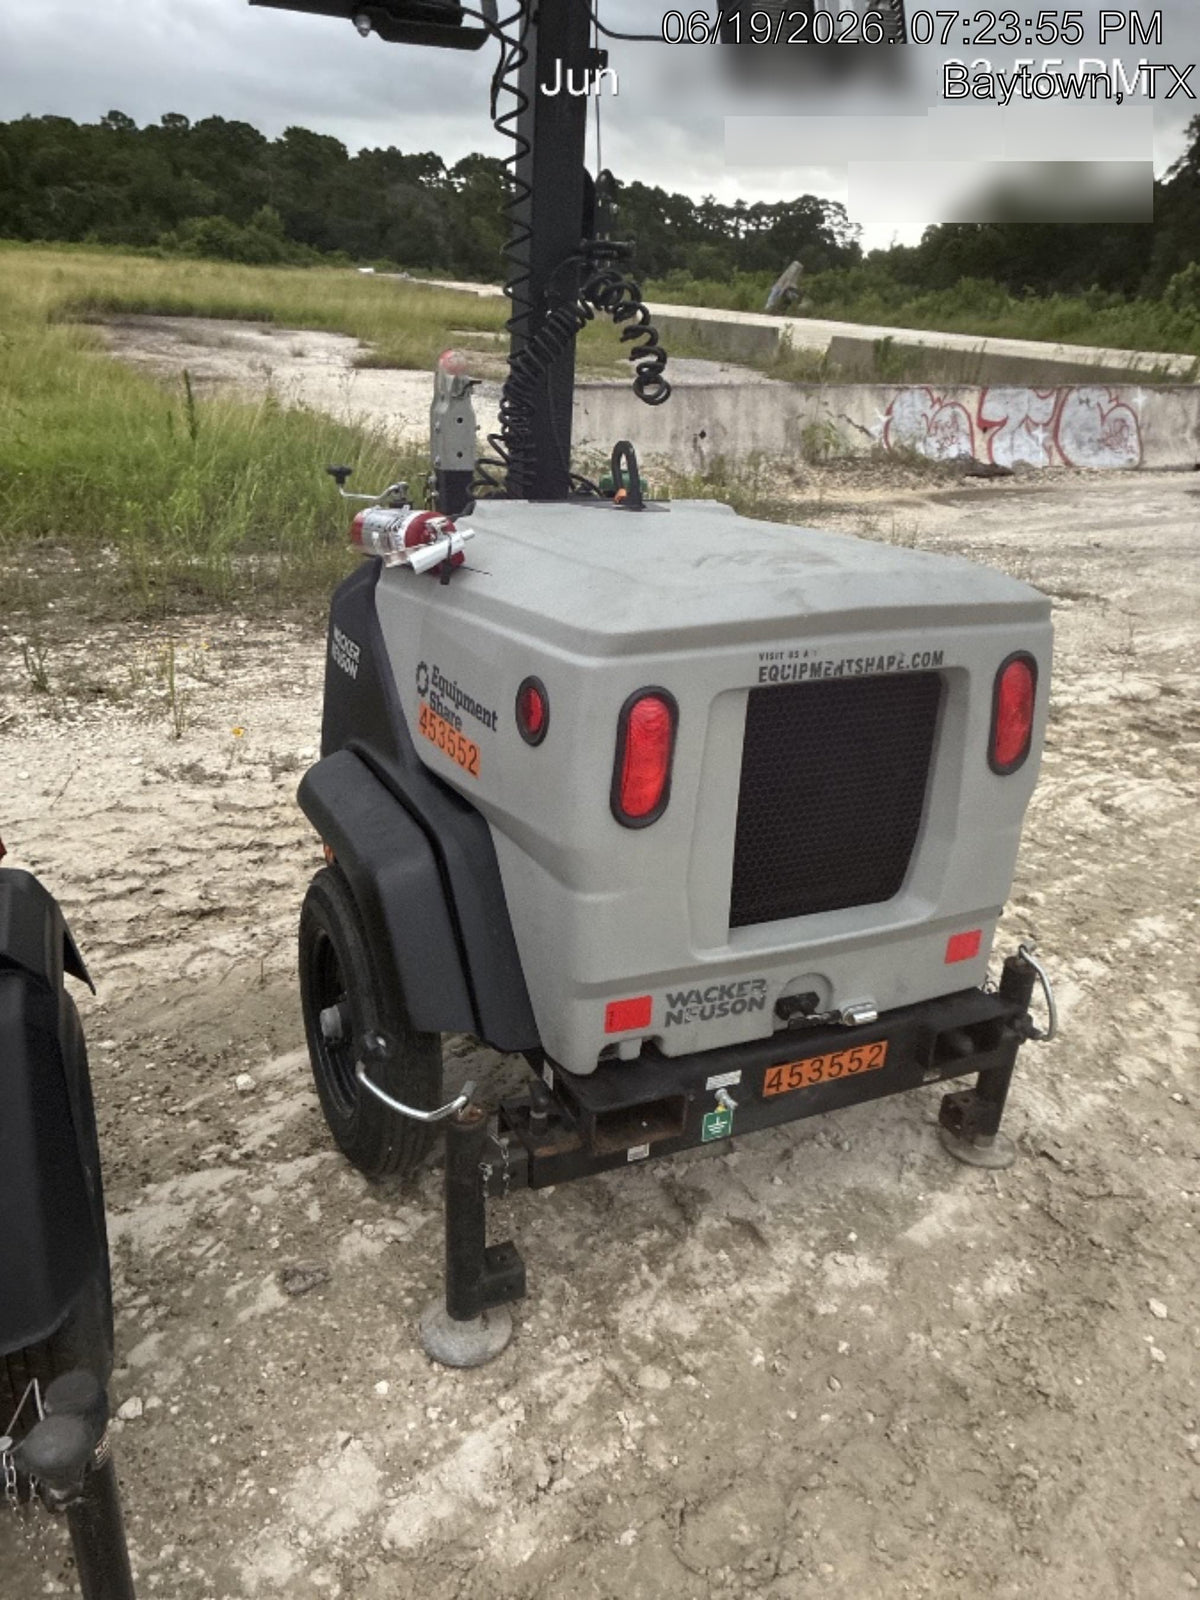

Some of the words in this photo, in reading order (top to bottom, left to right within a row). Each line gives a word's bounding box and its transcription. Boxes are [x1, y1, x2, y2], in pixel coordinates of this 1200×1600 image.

[759, 651, 785, 661] VISIT
[429, 690, 462, 732] Share
[431, 664, 498, 733] Equipment
[420, 707, 478, 777] 453552
[665, 979, 768, 1010] WACKER
[766, 1043, 884, 1092] 453552
